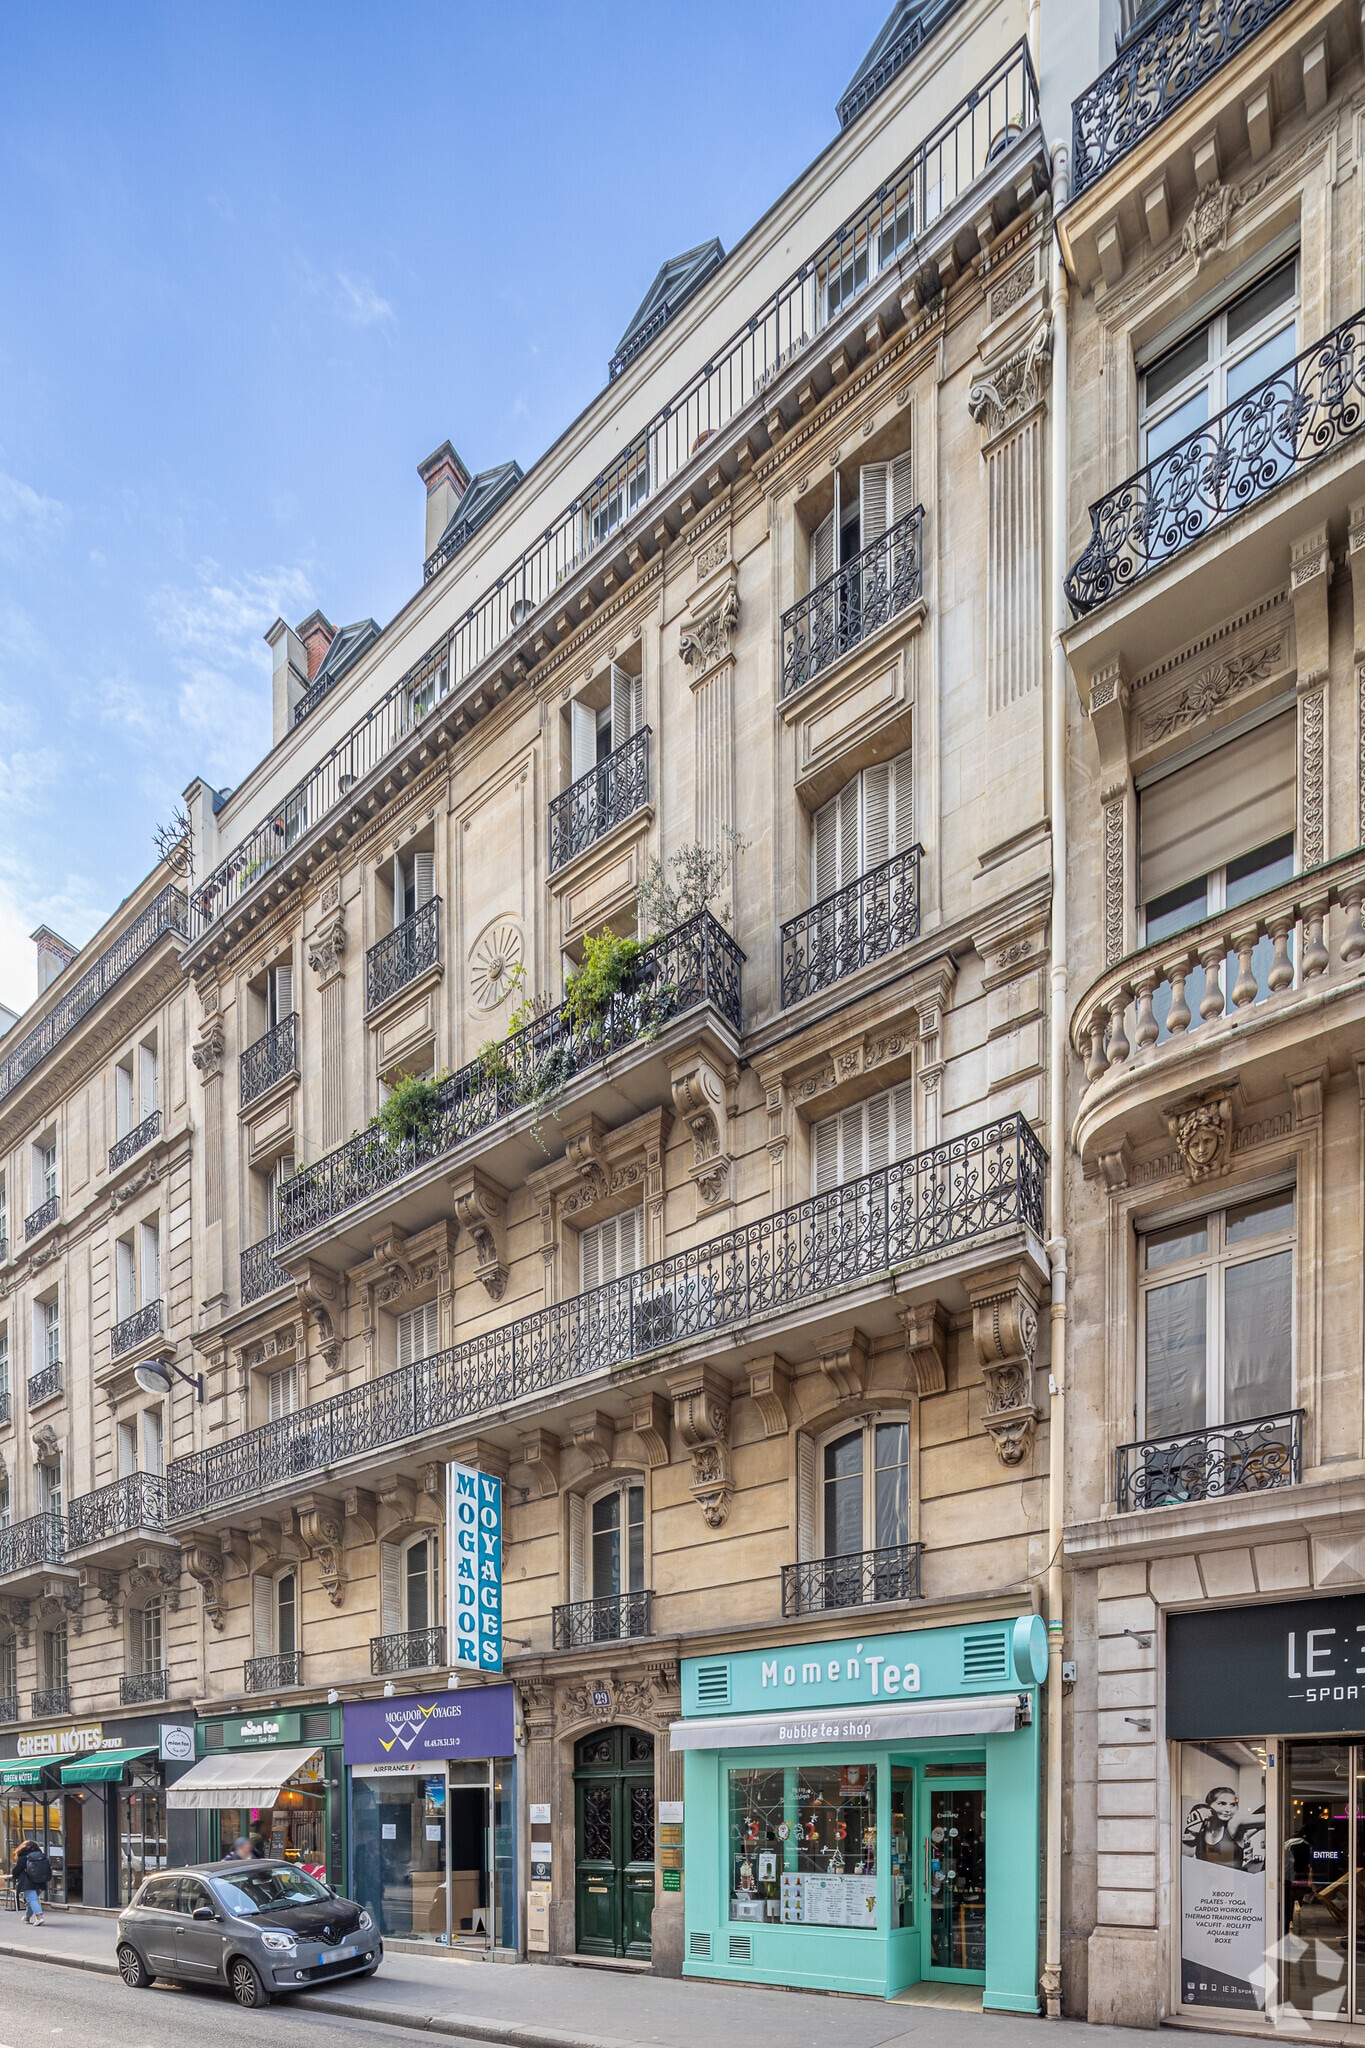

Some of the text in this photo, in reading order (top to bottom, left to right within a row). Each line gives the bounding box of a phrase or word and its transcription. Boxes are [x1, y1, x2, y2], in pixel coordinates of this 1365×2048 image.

[456, 1472, 477, 1662] MOGADOR
[480, 1478, 499, 1663] VOYAGES
[595, 1692, 607, 1704] 29
[385, 1710, 421, 1722] MOGADOR
[779, 1722, 871, 1739] Bubble tea shop
[17, 1733, 57, 1756] GREEN
[4, 1774, 18, 1782] GREEN
[1313, 1851, 1338, 1859] ENTREE
